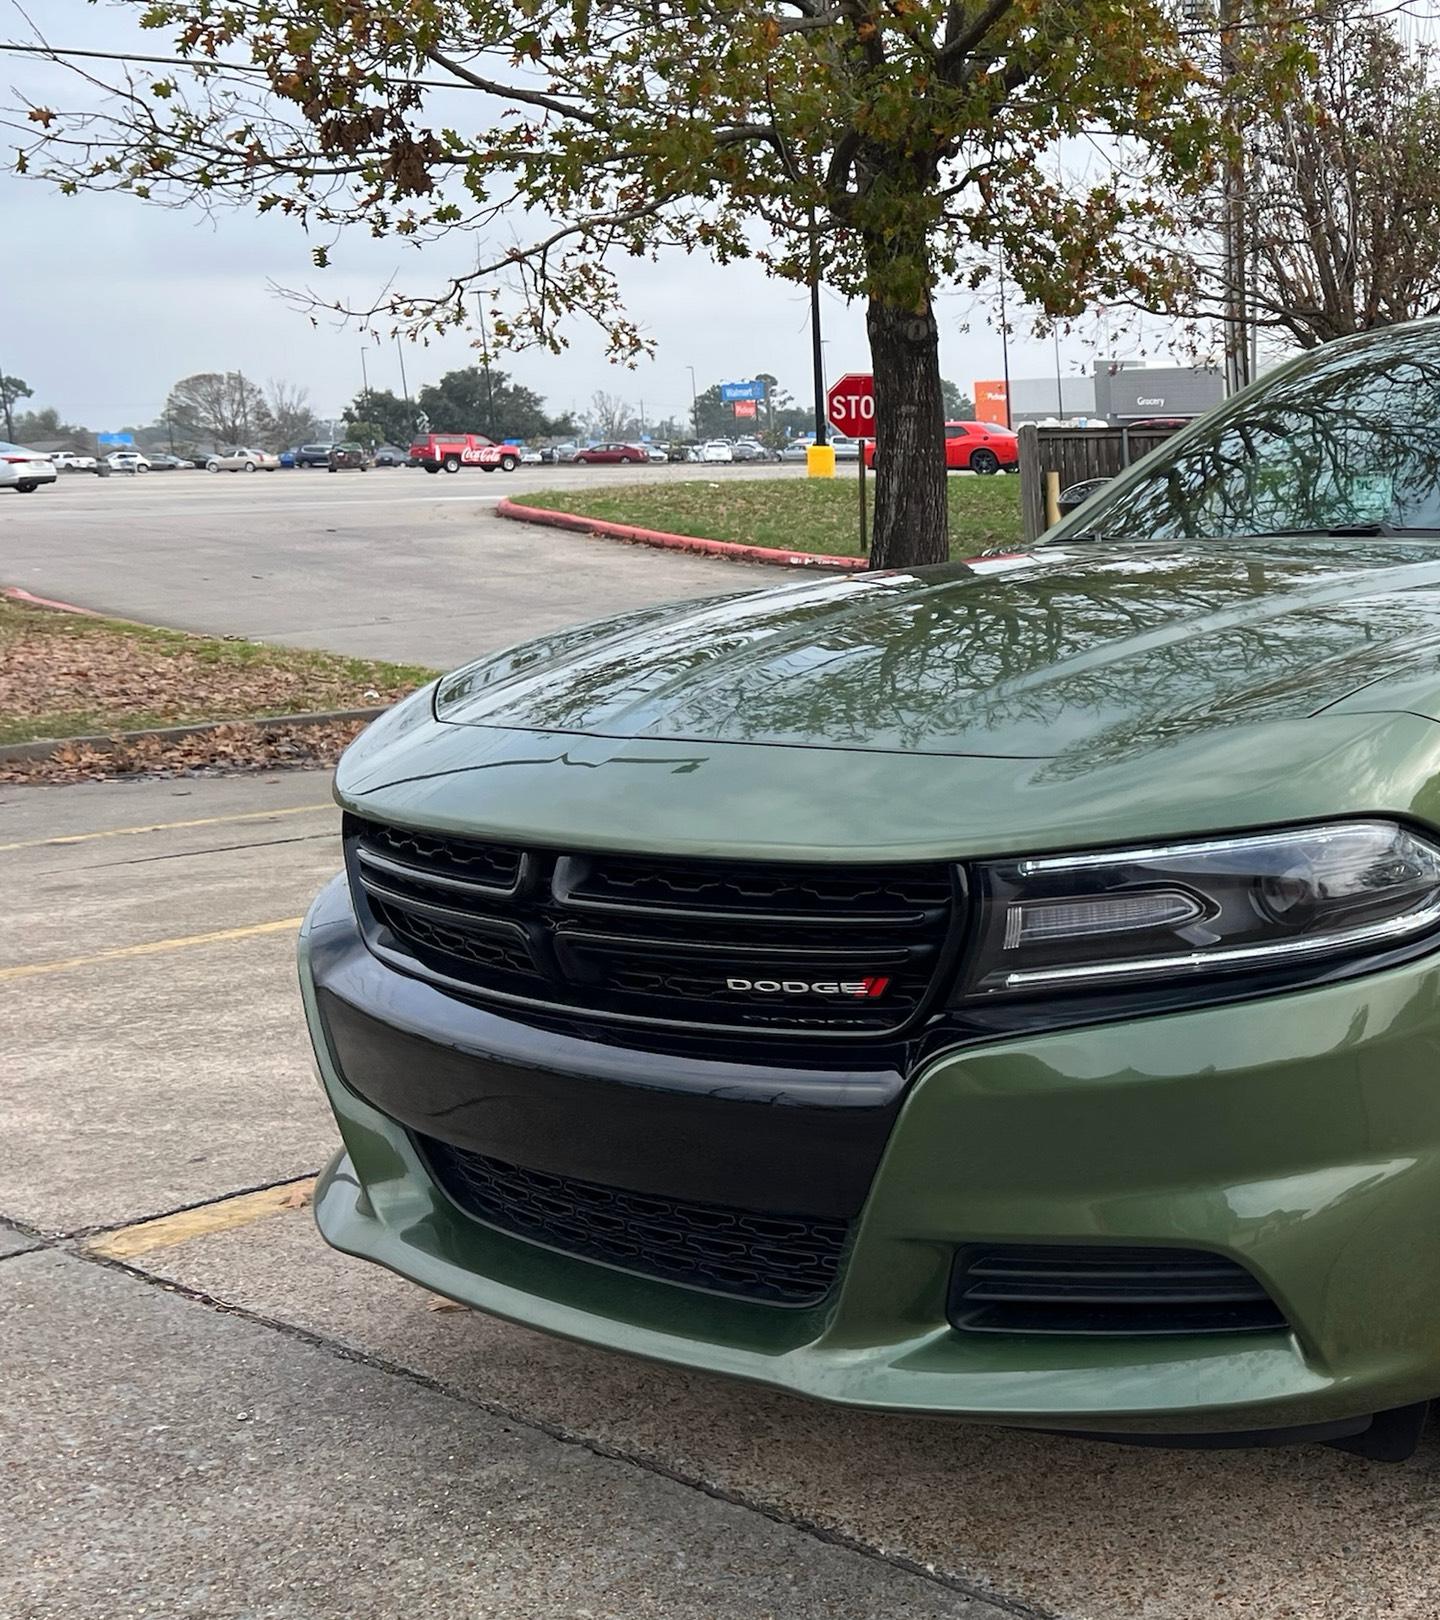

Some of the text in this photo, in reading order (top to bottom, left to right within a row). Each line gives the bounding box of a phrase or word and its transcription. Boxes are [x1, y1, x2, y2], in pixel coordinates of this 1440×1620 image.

[725, 387, 753, 398] Walmart
[832, 394, 875, 420] STO
[1136, 396, 1165, 408] Grocery
[726, 978, 868, 995] DODGE
